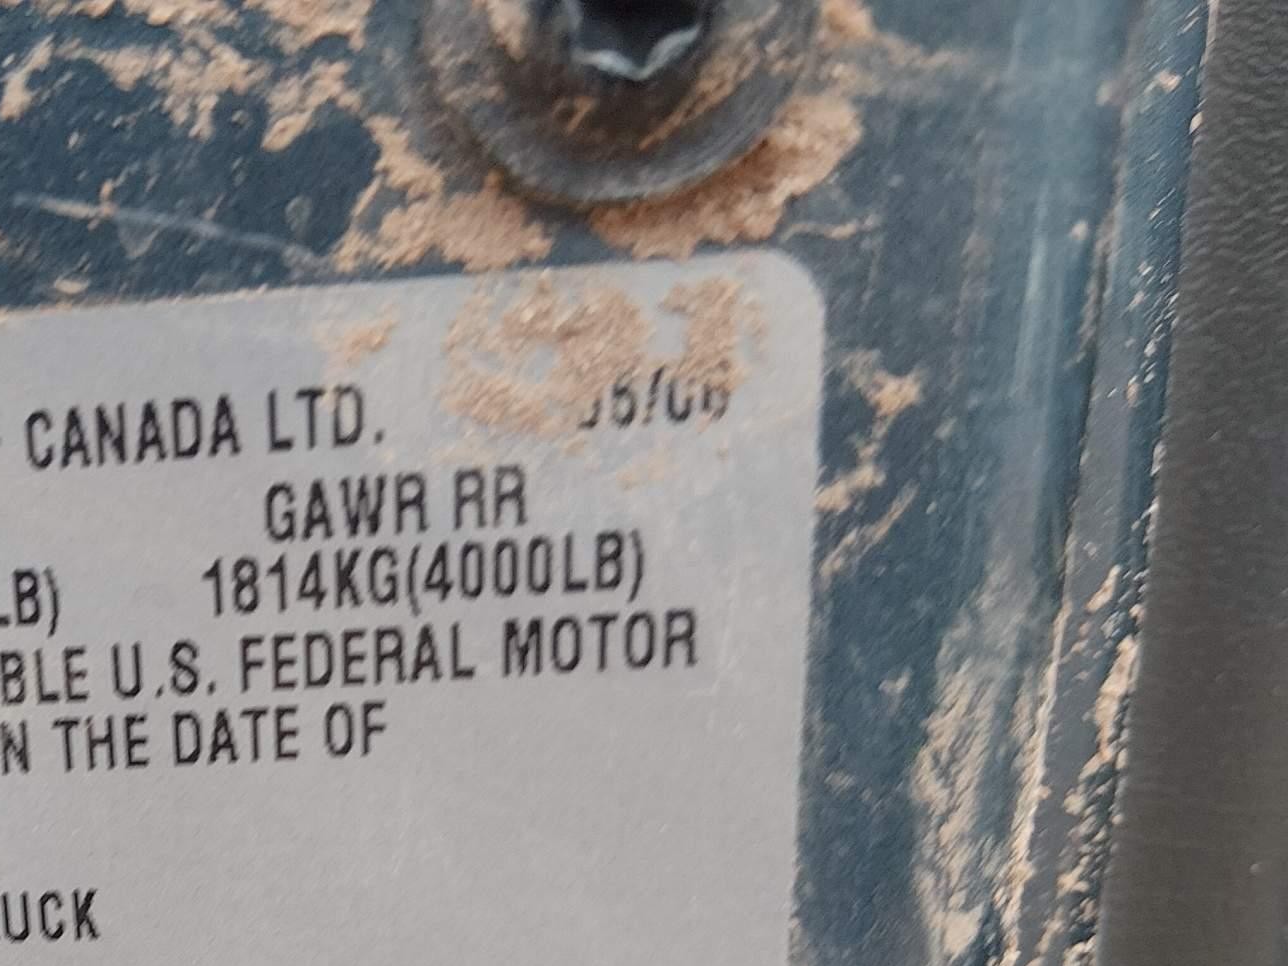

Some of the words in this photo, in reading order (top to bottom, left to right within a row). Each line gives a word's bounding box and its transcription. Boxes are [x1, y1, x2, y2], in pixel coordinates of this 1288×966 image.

[25, 393, 241, 471] CANADA
[267, 383, 385, 452] LTD.
[265, 472, 429, 542] GAWR
[453, 465, 527, 530] RR
[203, 528, 645, 619] 1814KG(4000LB)
[112, 640, 216, 700] U.S.
[240, 621, 475, 693] FEDERAL
[502, 608, 697, 680] MOTOR
[53, 714, 149, 772] THE
[172, 706, 299, 766] DATE
[325, 700, 387, 759] OF
